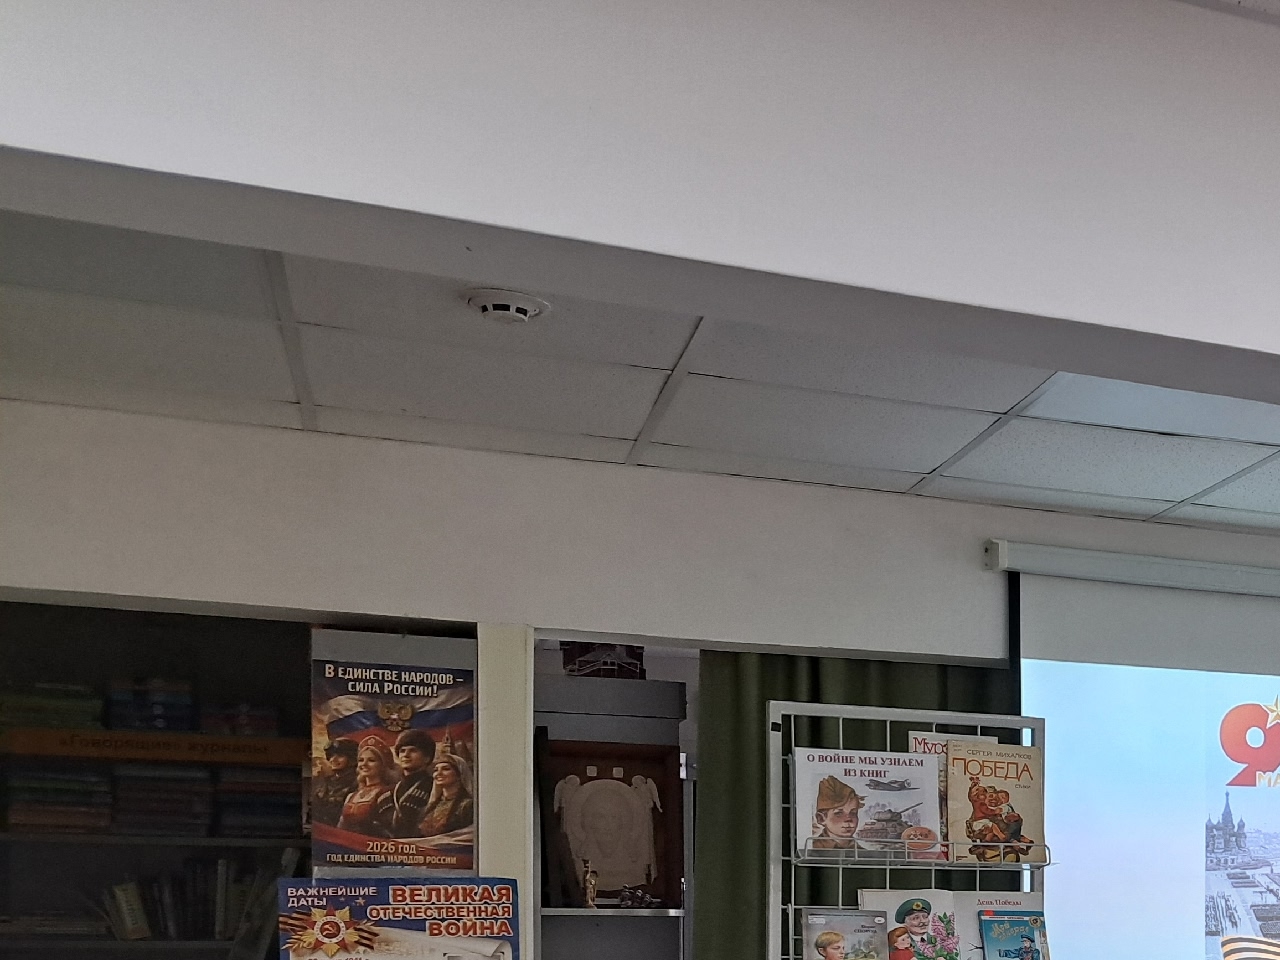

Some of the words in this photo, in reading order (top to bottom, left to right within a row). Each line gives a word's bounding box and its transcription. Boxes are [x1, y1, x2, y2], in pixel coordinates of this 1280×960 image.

[325, 664, 334, 678] В
[338, 667, 398, 681] ЕДИНСТВЕ
[402, 672, 453, 684] НАРОДОВ
[348, 682, 380, 693] СИЛА
[384, 684, 437, 697] РОССИИ!
[807, 754, 814, 763] О
[818, 753, 855, 765] ВОЙНЕ
[859, 756, 877, 766] МЫ
[880, 757, 924, 767] УЗНАЕМ
[966, 749, 993, 757] СЕРГЕЙ
[996, 751, 1032, 760] МИХАЛКОВ
[844, 768, 857, 776] ИЗ
[860, 769, 889, 778] КНИГ
[952, 758, 1034, 781] ПОБЕДА
[367, 842, 395, 854] 2026
[327, 854, 342, 862] ГОД
[344, 855, 385, 863] ЕДИНСТВА
[388, 855, 424, 864] НАРОДОВ
[427, 857, 457, 865] РОССИИ
[288, 886, 377, 896] ВАЖНЕЙШИЕ
[389, 885, 512, 905] ВЕЛИКАЯ
[288, 898, 327, 908] ДАТЫ
[367, 906, 511, 920] ОТЕЧЕСТВЕННАЯ
[428, 918, 513, 937] ВОЙНА
